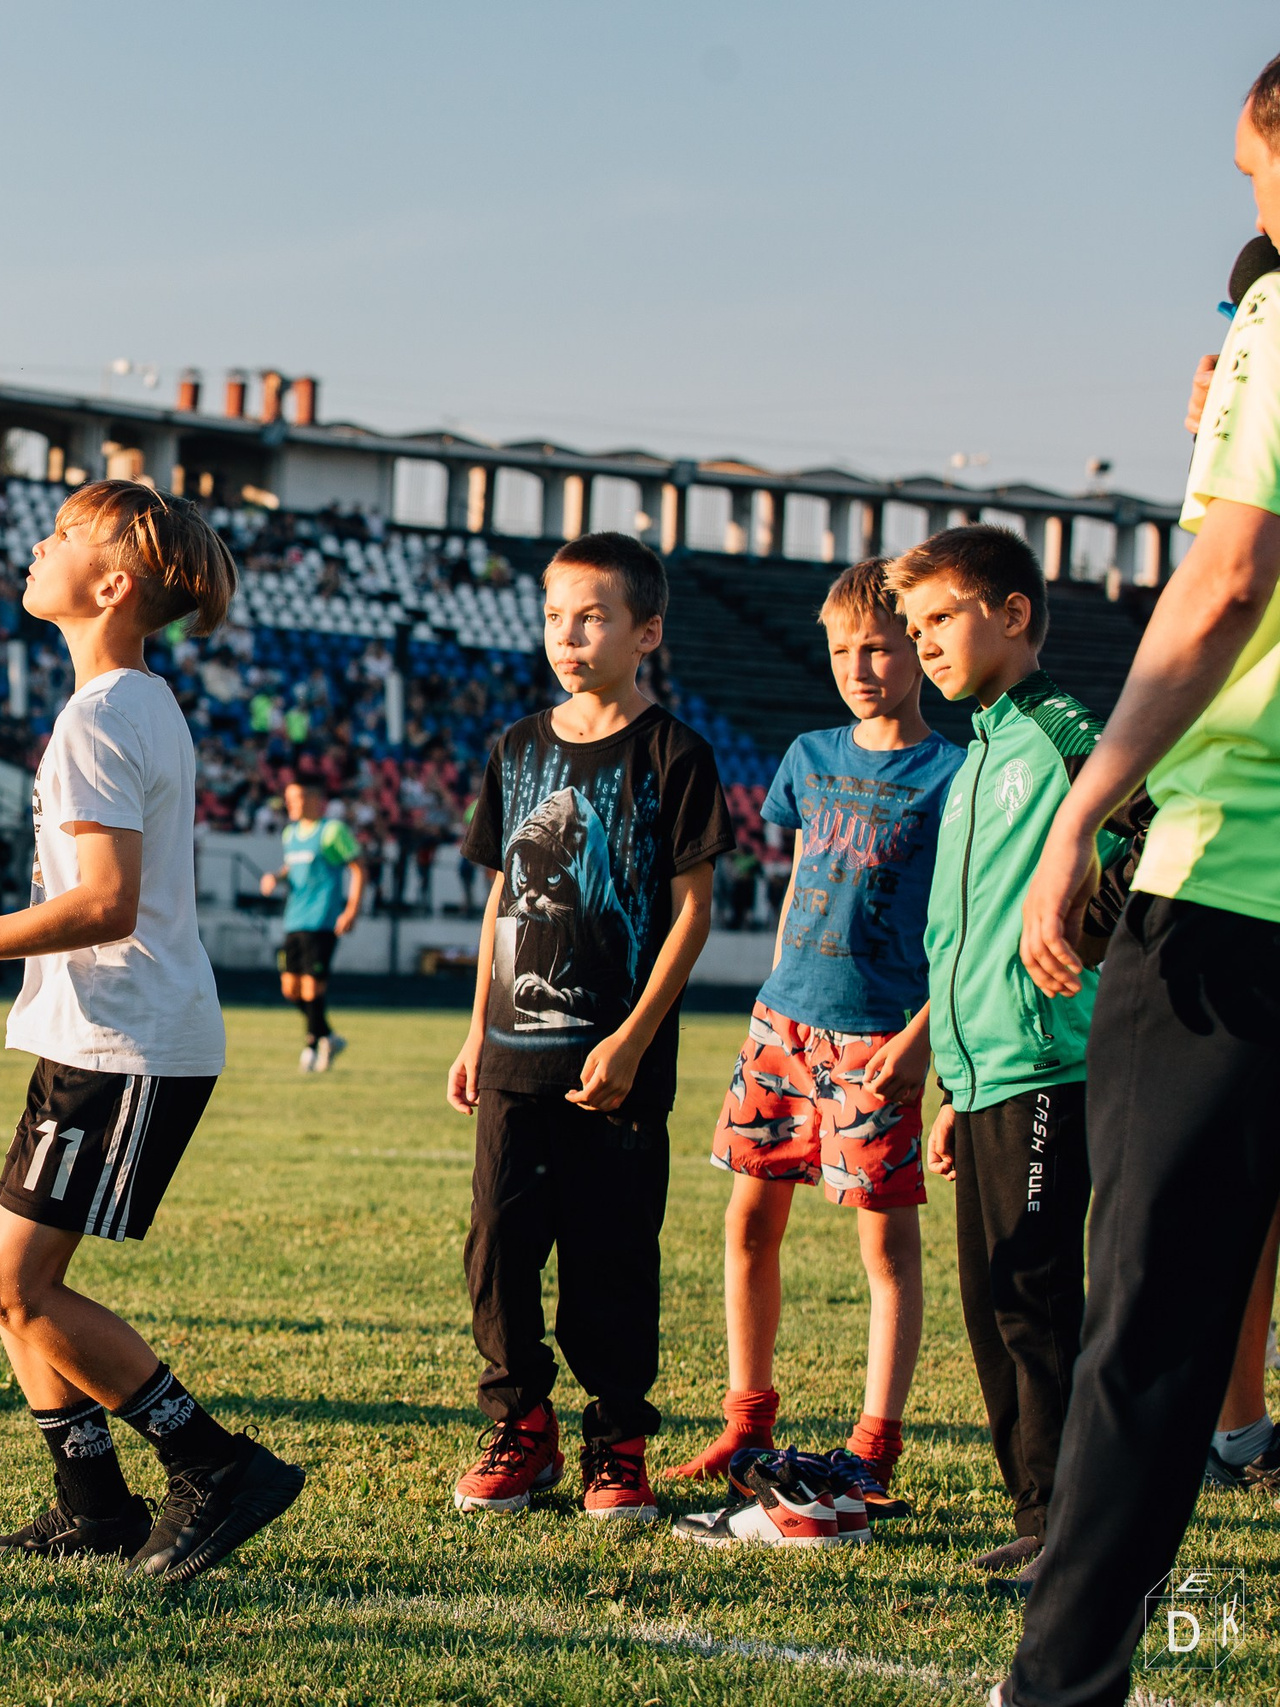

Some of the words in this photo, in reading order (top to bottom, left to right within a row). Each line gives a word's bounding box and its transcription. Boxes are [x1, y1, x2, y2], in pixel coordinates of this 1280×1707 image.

[804, 773, 924, 801] STREET
[1031, 1093, 1050, 1153] CASH
[22, 1119, 86, 1201] 11
[1027, 1162, 1043, 1212] RULE
[64, 1435, 113, 1459] Kappa
